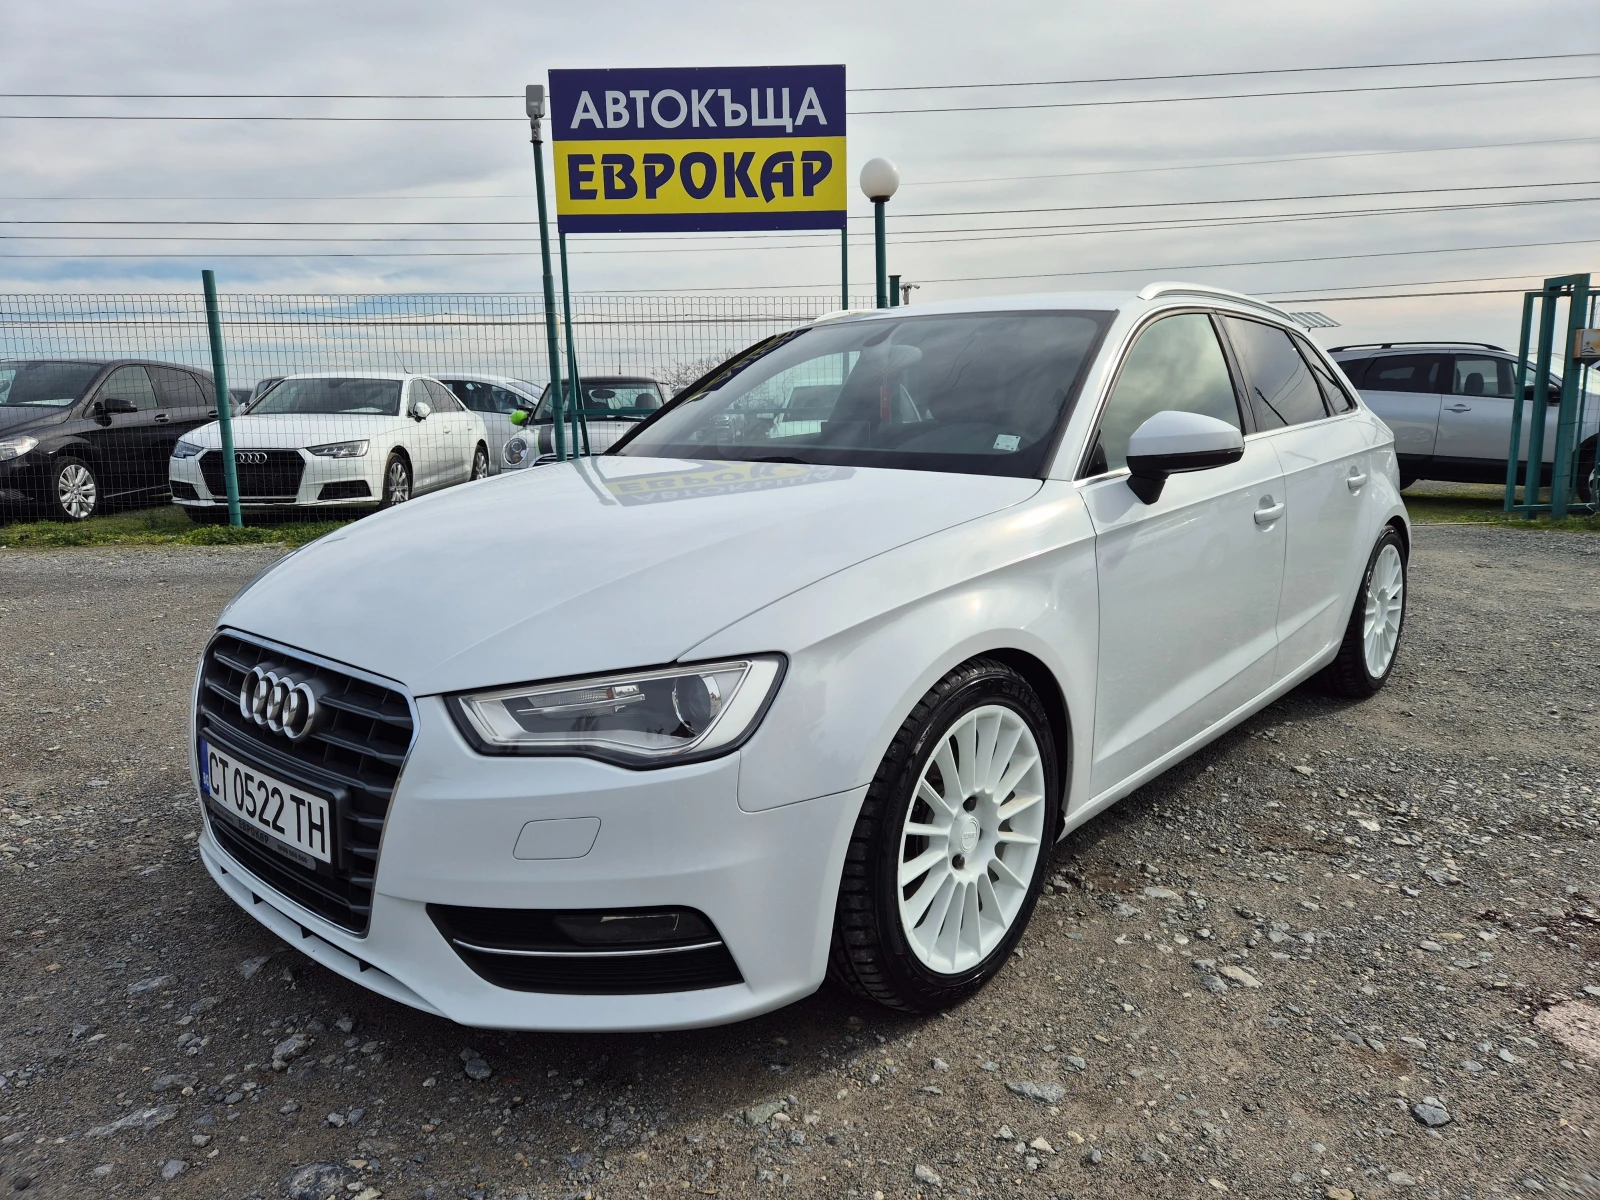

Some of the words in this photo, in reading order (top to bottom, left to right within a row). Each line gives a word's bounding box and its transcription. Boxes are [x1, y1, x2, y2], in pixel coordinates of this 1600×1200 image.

[570, 87, 828, 133] АВТОКЪЩА
[567, 150, 833, 203] ЕВРОКАР
[209, 752, 229, 802] CT
[234, 767, 285, 835] 0522
[290, 794, 326, 854] TH
